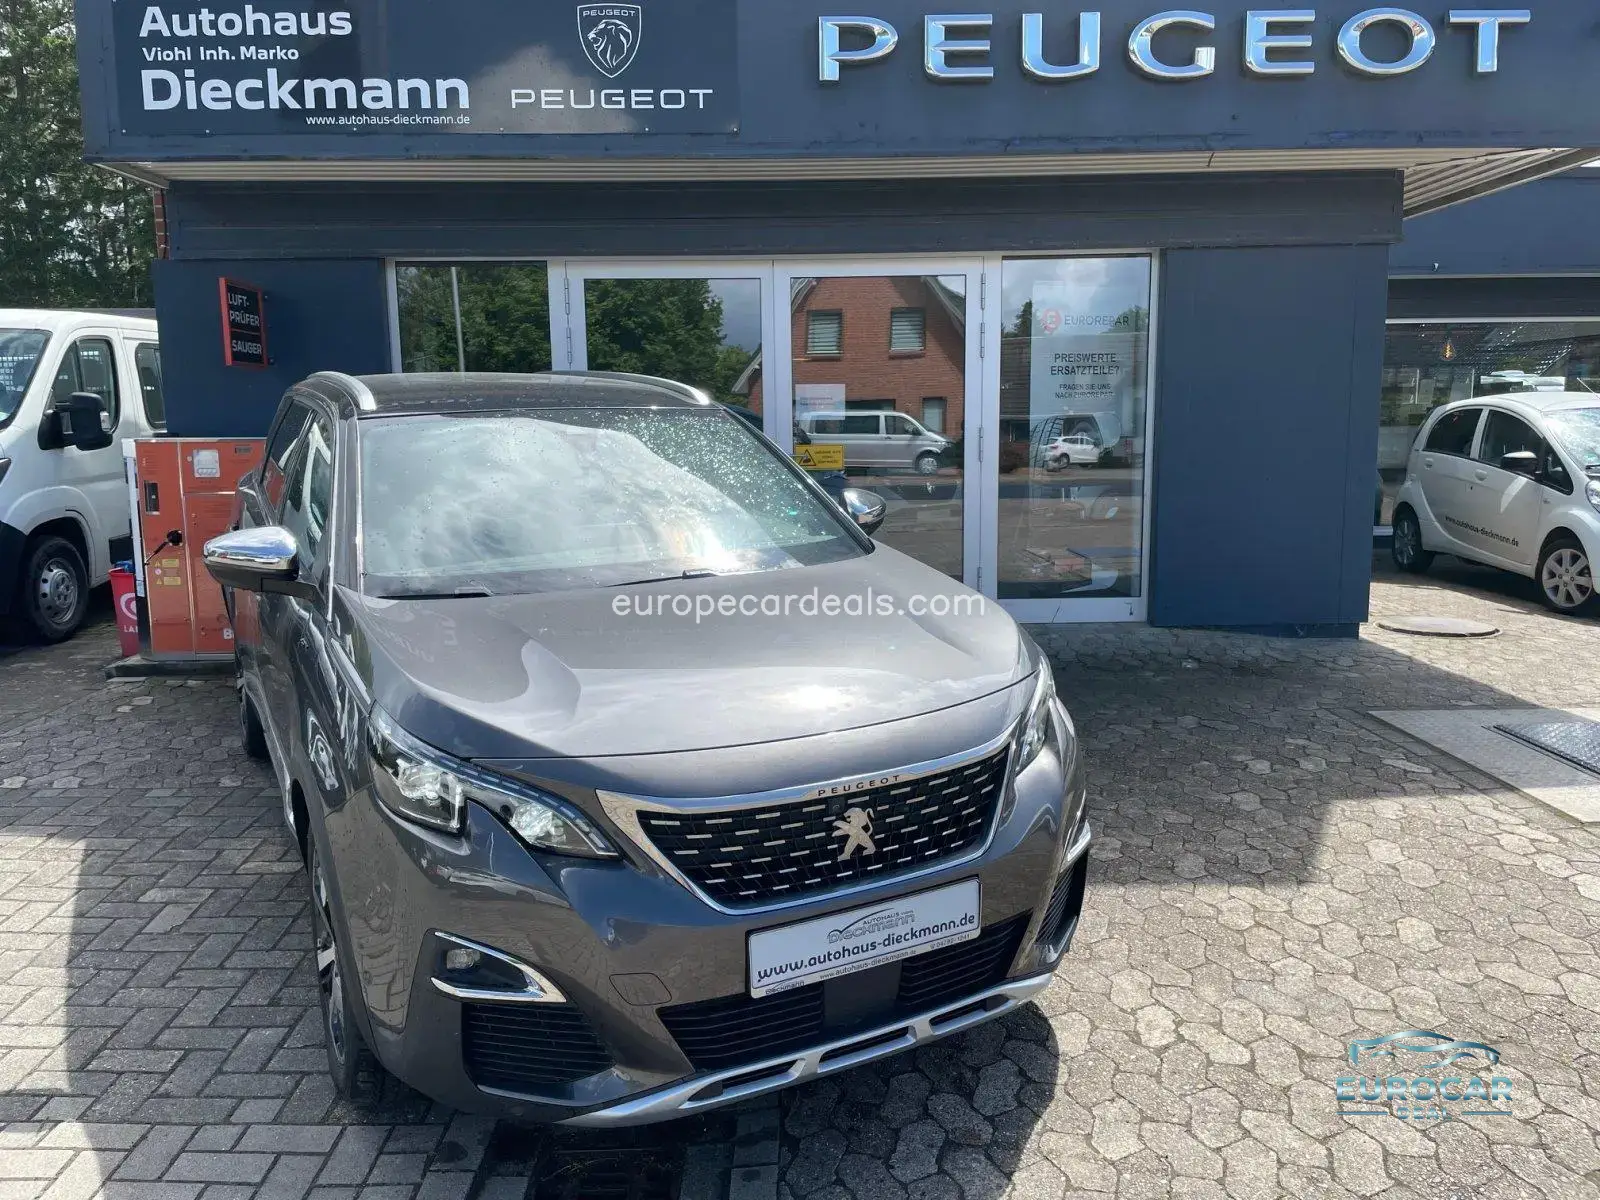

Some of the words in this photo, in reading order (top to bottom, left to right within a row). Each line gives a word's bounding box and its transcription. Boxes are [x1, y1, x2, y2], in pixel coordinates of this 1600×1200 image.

[139, 4, 352, 38] Autohaus
[582, 9, 636, 17] PEUGEOT
[142, 46, 192, 62] Viohl
[199, 46, 236, 61] Inh.
[239, 45, 299, 60] Marko
[817, 9, 1531, 82] PEUGEOT
[140, 67, 470, 110] Dieckmann
[511, 89, 714, 109] PEUGEOT
[305, 113, 471, 126] www.autohaus-dieckmann.de
[227, 292, 250, 308] LUFT-
[229, 309, 260, 328] PRÜFER
[1064, 315, 1129, 327] EUROREPAR
[231, 339, 262, 356] SAUGER
[1054, 352, 1117, 363] PREISWERTE
[1050, 365, 1120, 376] ERSATZTEILE?
[818, 774, 900, 797] PEUGEOT
[862, 911, 900, 925] AUTOHAUS
[757, 912, 976, 983] www.autohaus-dieckmann.de
